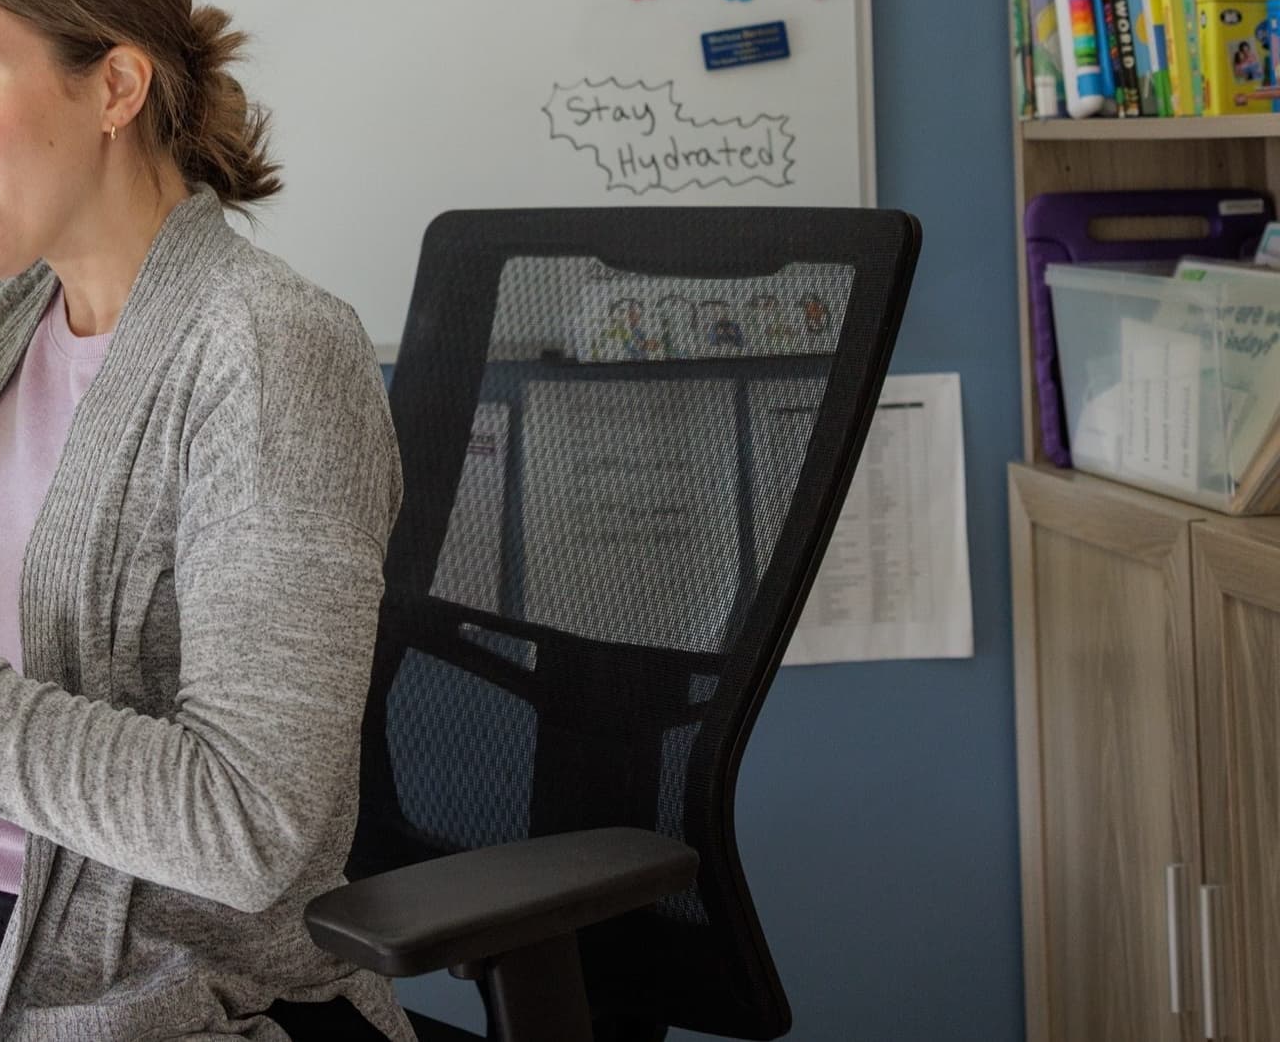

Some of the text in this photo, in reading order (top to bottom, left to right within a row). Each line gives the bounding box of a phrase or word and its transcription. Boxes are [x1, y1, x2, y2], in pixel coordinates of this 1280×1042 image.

[1113, 0, 1136, 69] WORLD
[567, 95, 655, 137] Stay
[618, 126, 775, 187] Hydrated
